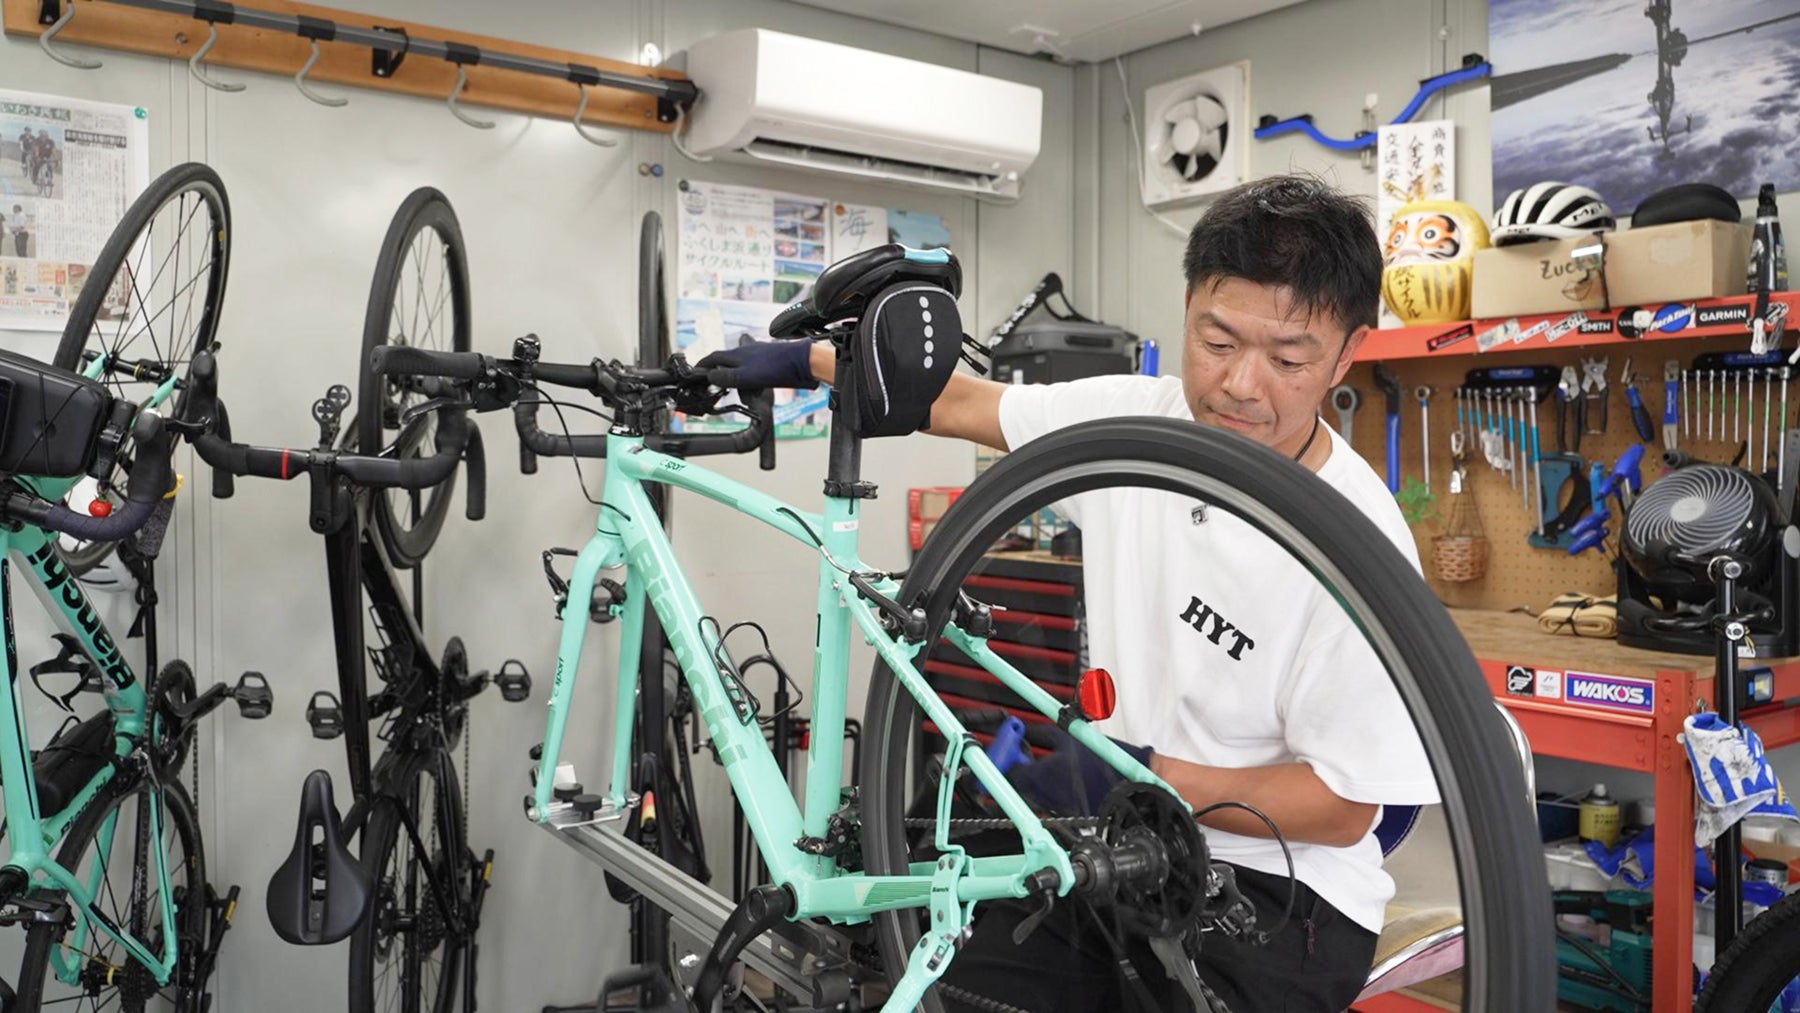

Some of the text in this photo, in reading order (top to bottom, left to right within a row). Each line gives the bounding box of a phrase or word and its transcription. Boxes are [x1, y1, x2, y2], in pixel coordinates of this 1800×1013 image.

[1580, 321, 1611, 332] SMITH
[1700, 308, 1747, 322] GARMIN
[26, 541, 136, 691] Bianchi
[1179, 595, 1255, 661] HYT
